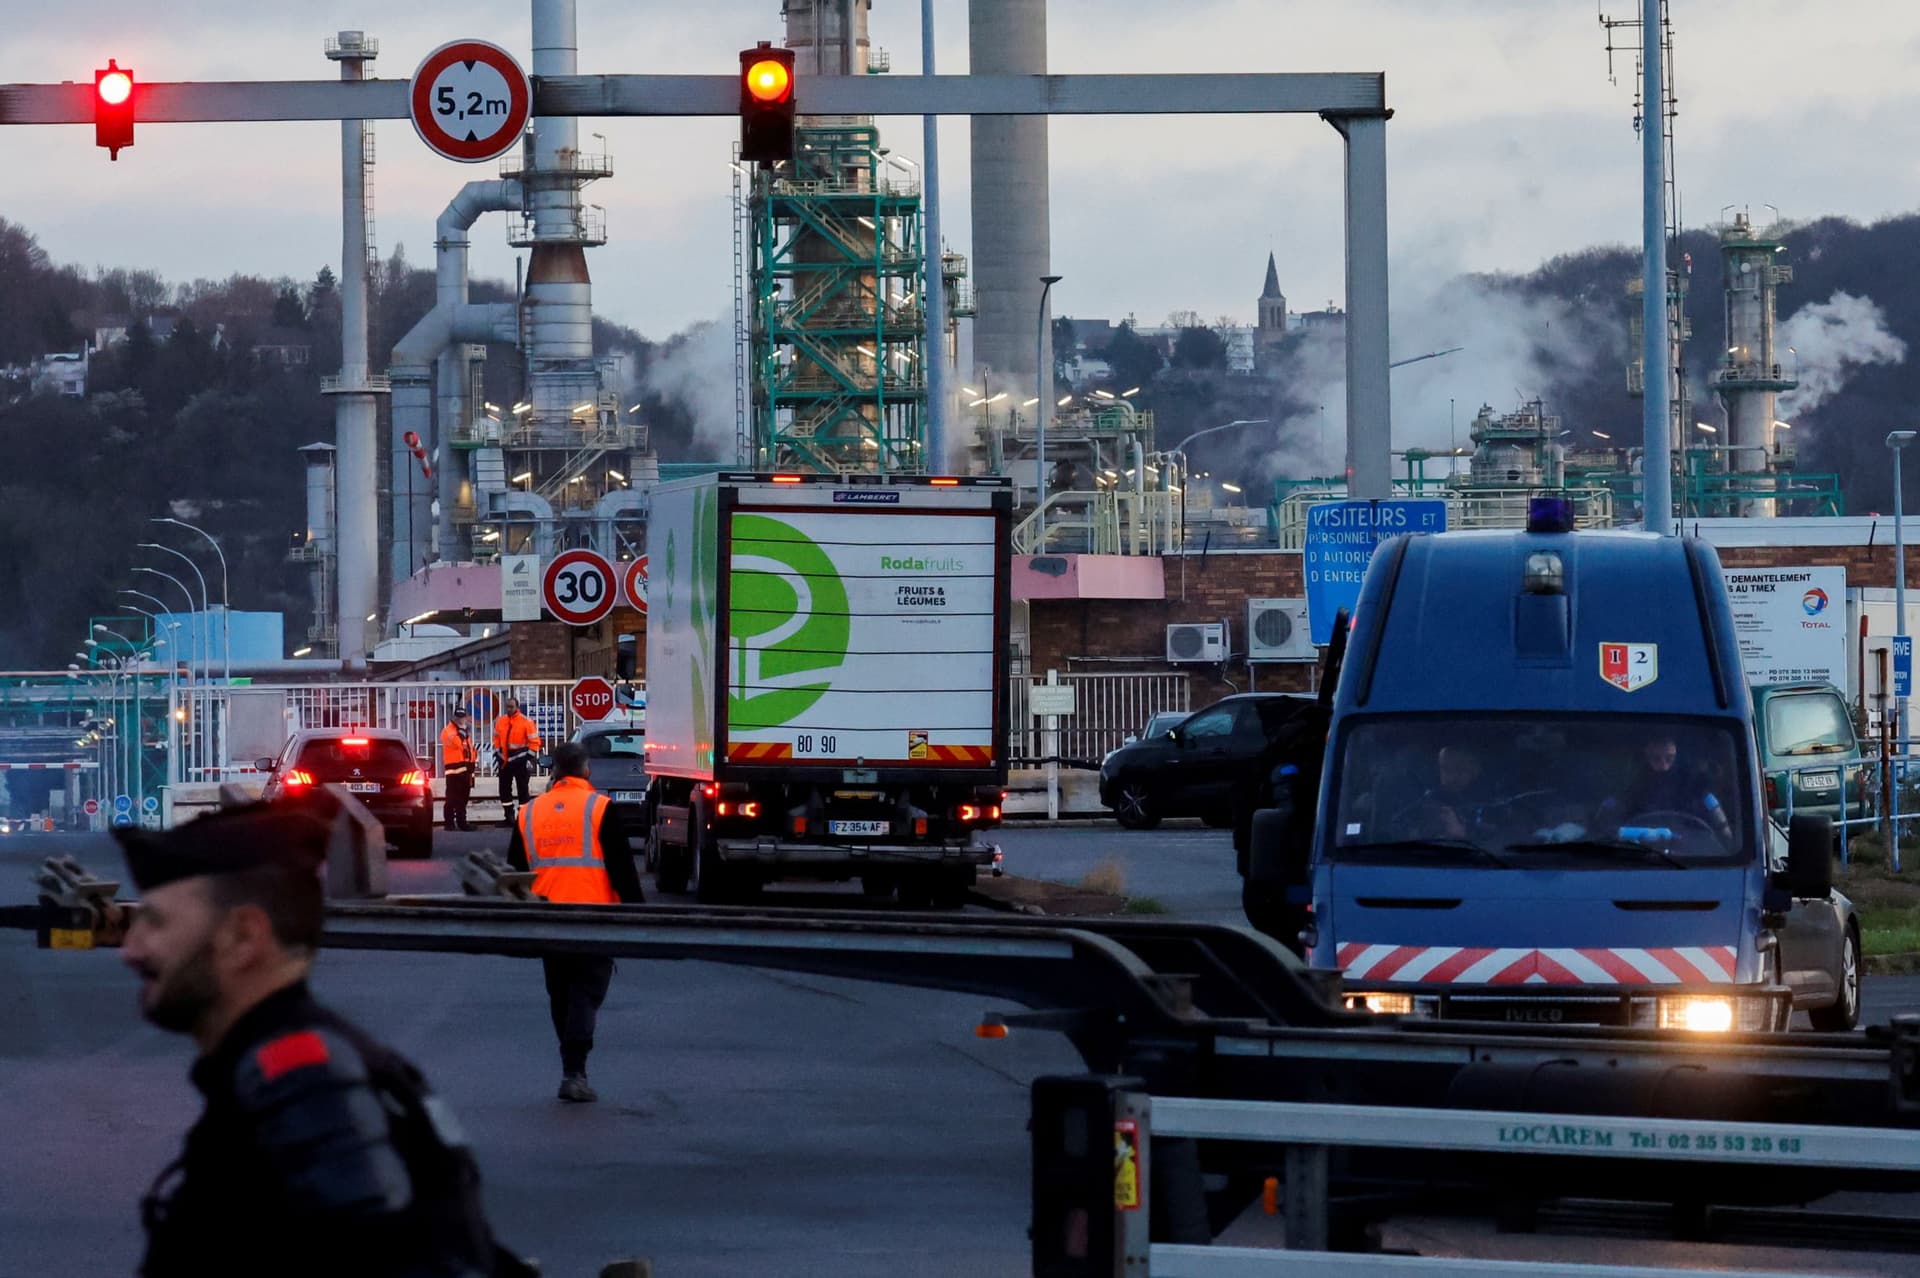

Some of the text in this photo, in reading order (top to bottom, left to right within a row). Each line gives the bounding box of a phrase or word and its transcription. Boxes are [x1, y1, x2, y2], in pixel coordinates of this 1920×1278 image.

[437, 87, 507, 120] 5,2m
[847, 493, 898, 501] LAMBERET
[1313, 507, 1437, 527] VISITEURS ET
[880, 556, 964, 572] Rodafruits
[1731, 574, 1811, 583] DEMANTELEMENT
[558, 570, 603, 603] 30
[898, 586, 944, 596] FRUITS &
[1736, 584, 1748, 592] AU
[1751, 584, 1776, 592] TMEX
[897, 594, 946, 606] LÉGUMES
[1801, 621, 1831, 629] TOTAL
[1634, 651, 1648, 664] 2
[575, 693, 610, 707] STOP
[797, 735, 836, 753] 80 90
[1505, 1007, 1563, 1022] IVECO
[1498, 1125, 1613, 1146] LOCAREM
[1668, 1134, 1690, 1149] 02
[1696, 1135, 1717, 1150] 35
[1723, 1136, 1745, 1151] 53
[1752, 1137, 1772, 1152] 25
[1778, 1138, 1800, 1153] 63
